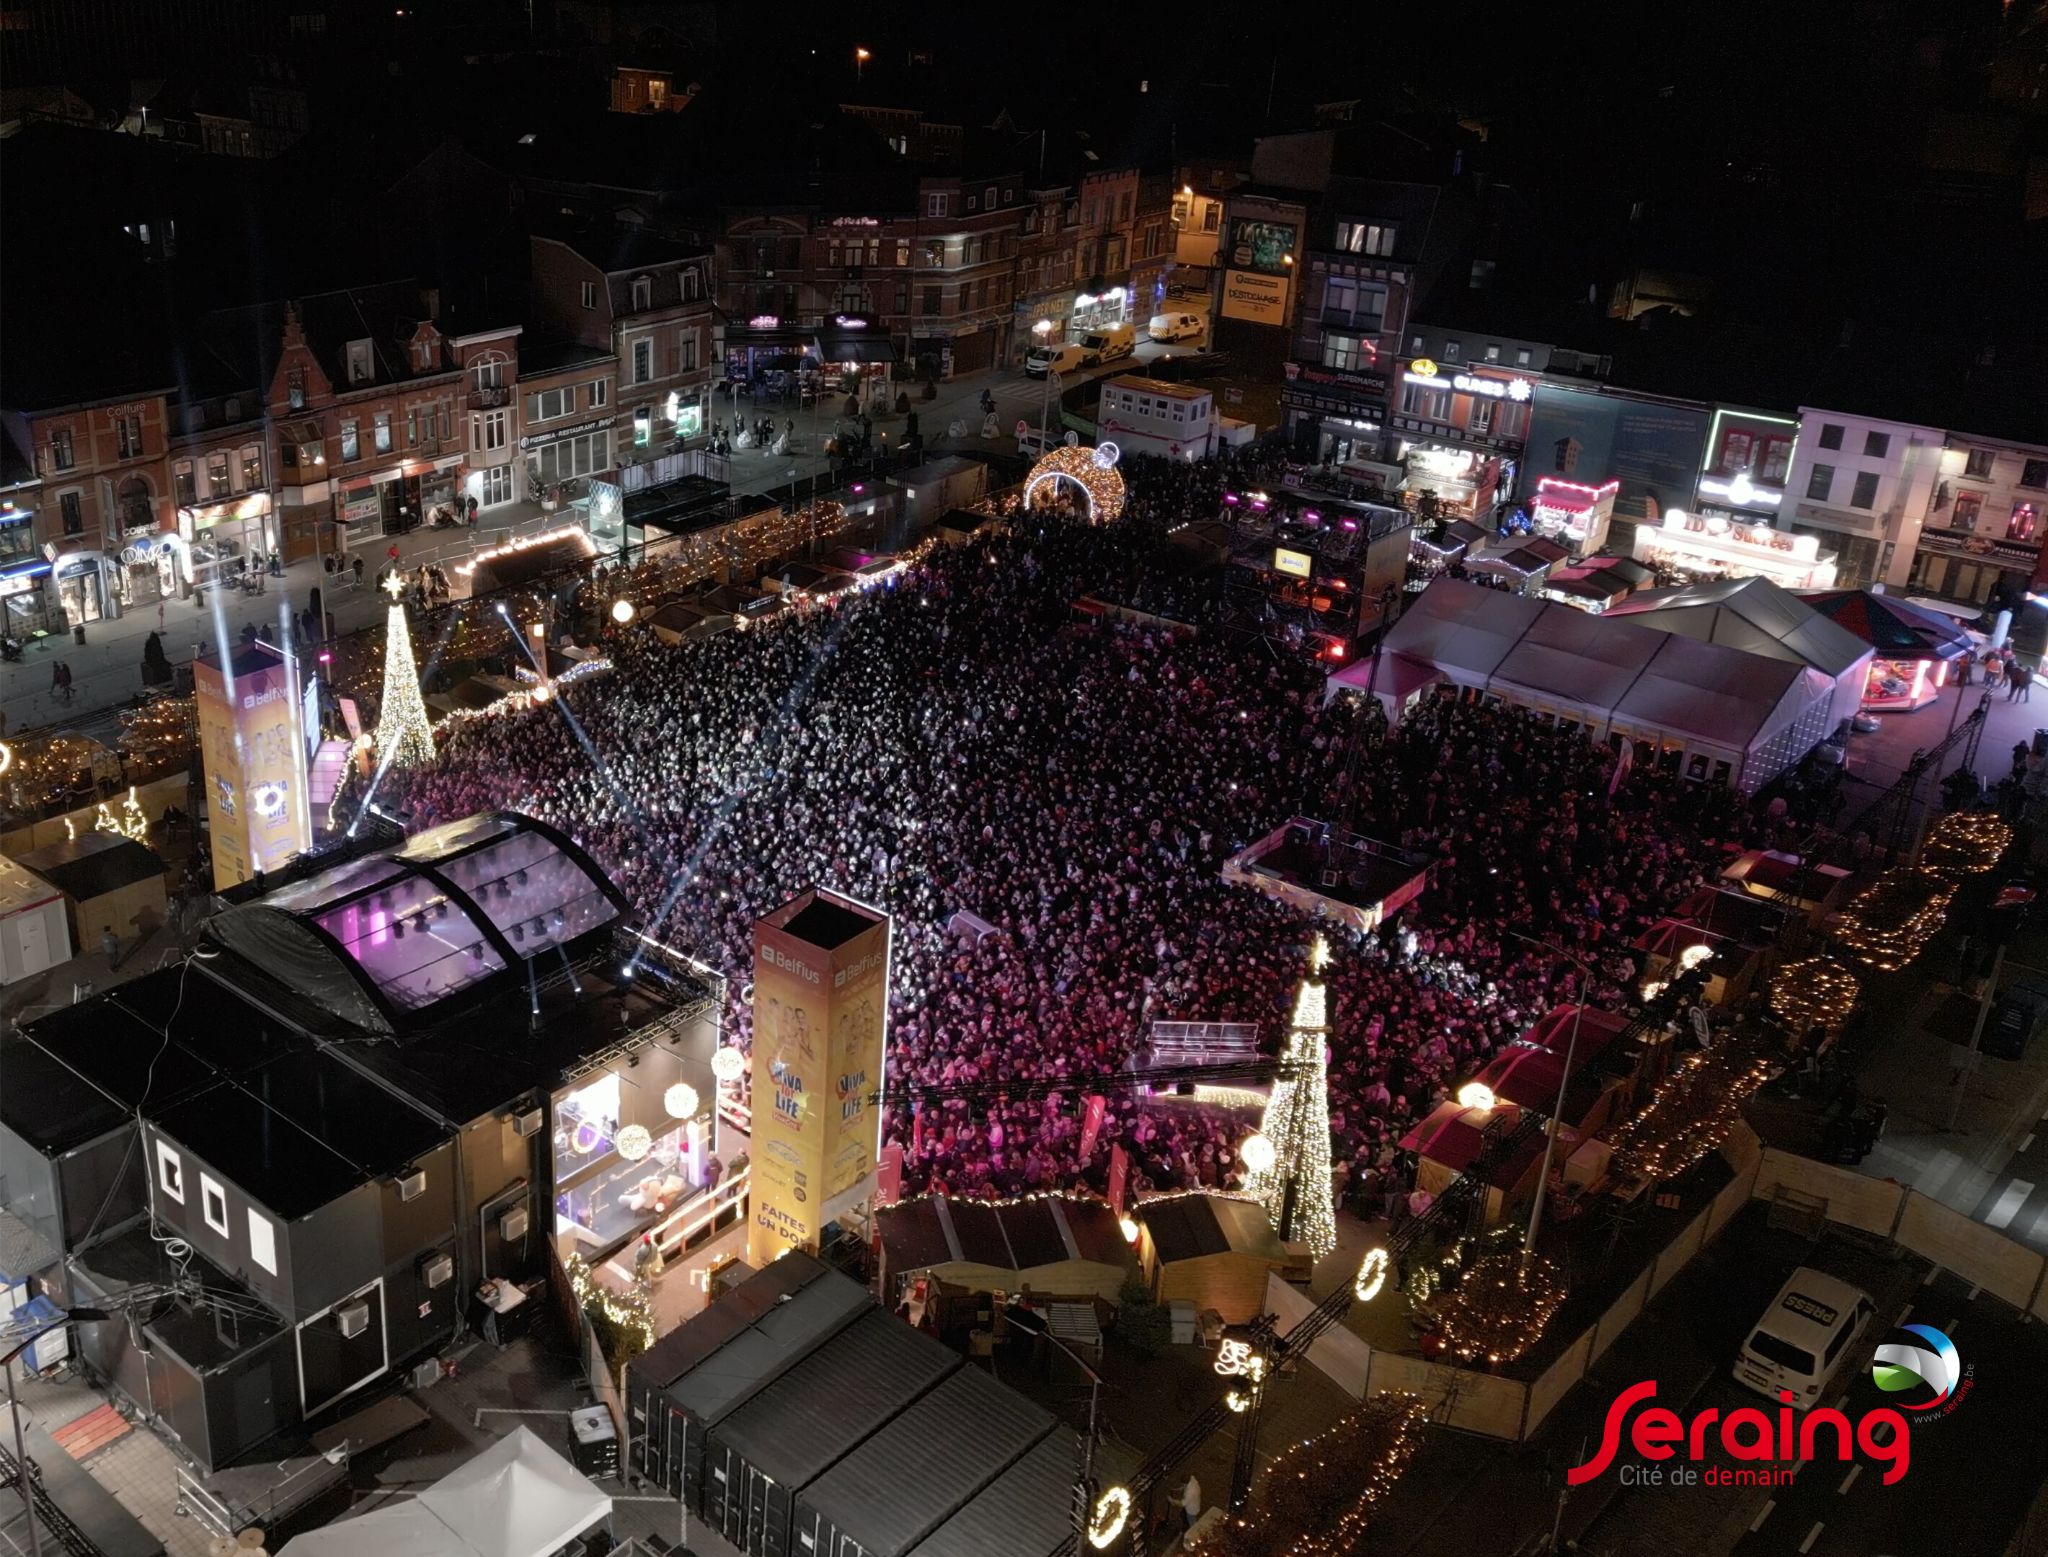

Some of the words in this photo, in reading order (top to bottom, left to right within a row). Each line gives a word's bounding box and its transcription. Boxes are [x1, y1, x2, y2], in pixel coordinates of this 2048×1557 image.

[1337, 373, 1386, 389] SUPERMARCHE
[106, 402, 146, 418] Coiffure
[45, 416, 75, 430] Olivier
[122, 520, 161, 536] COIFFURE
[1995, 546, 2038, 560] PATISSERIE
[256, 687, 292, 706] Belfius
[776, 950, 819, 984] Belfius
[847, 952, 883, 981] Belfius
[761, 1201, 806, 1234] FAITES
[757, 1214, 776, 1231] UN
[779, 1226, 805, 1245] DO
[1784, 1295, 1836, 1324] PRESS
